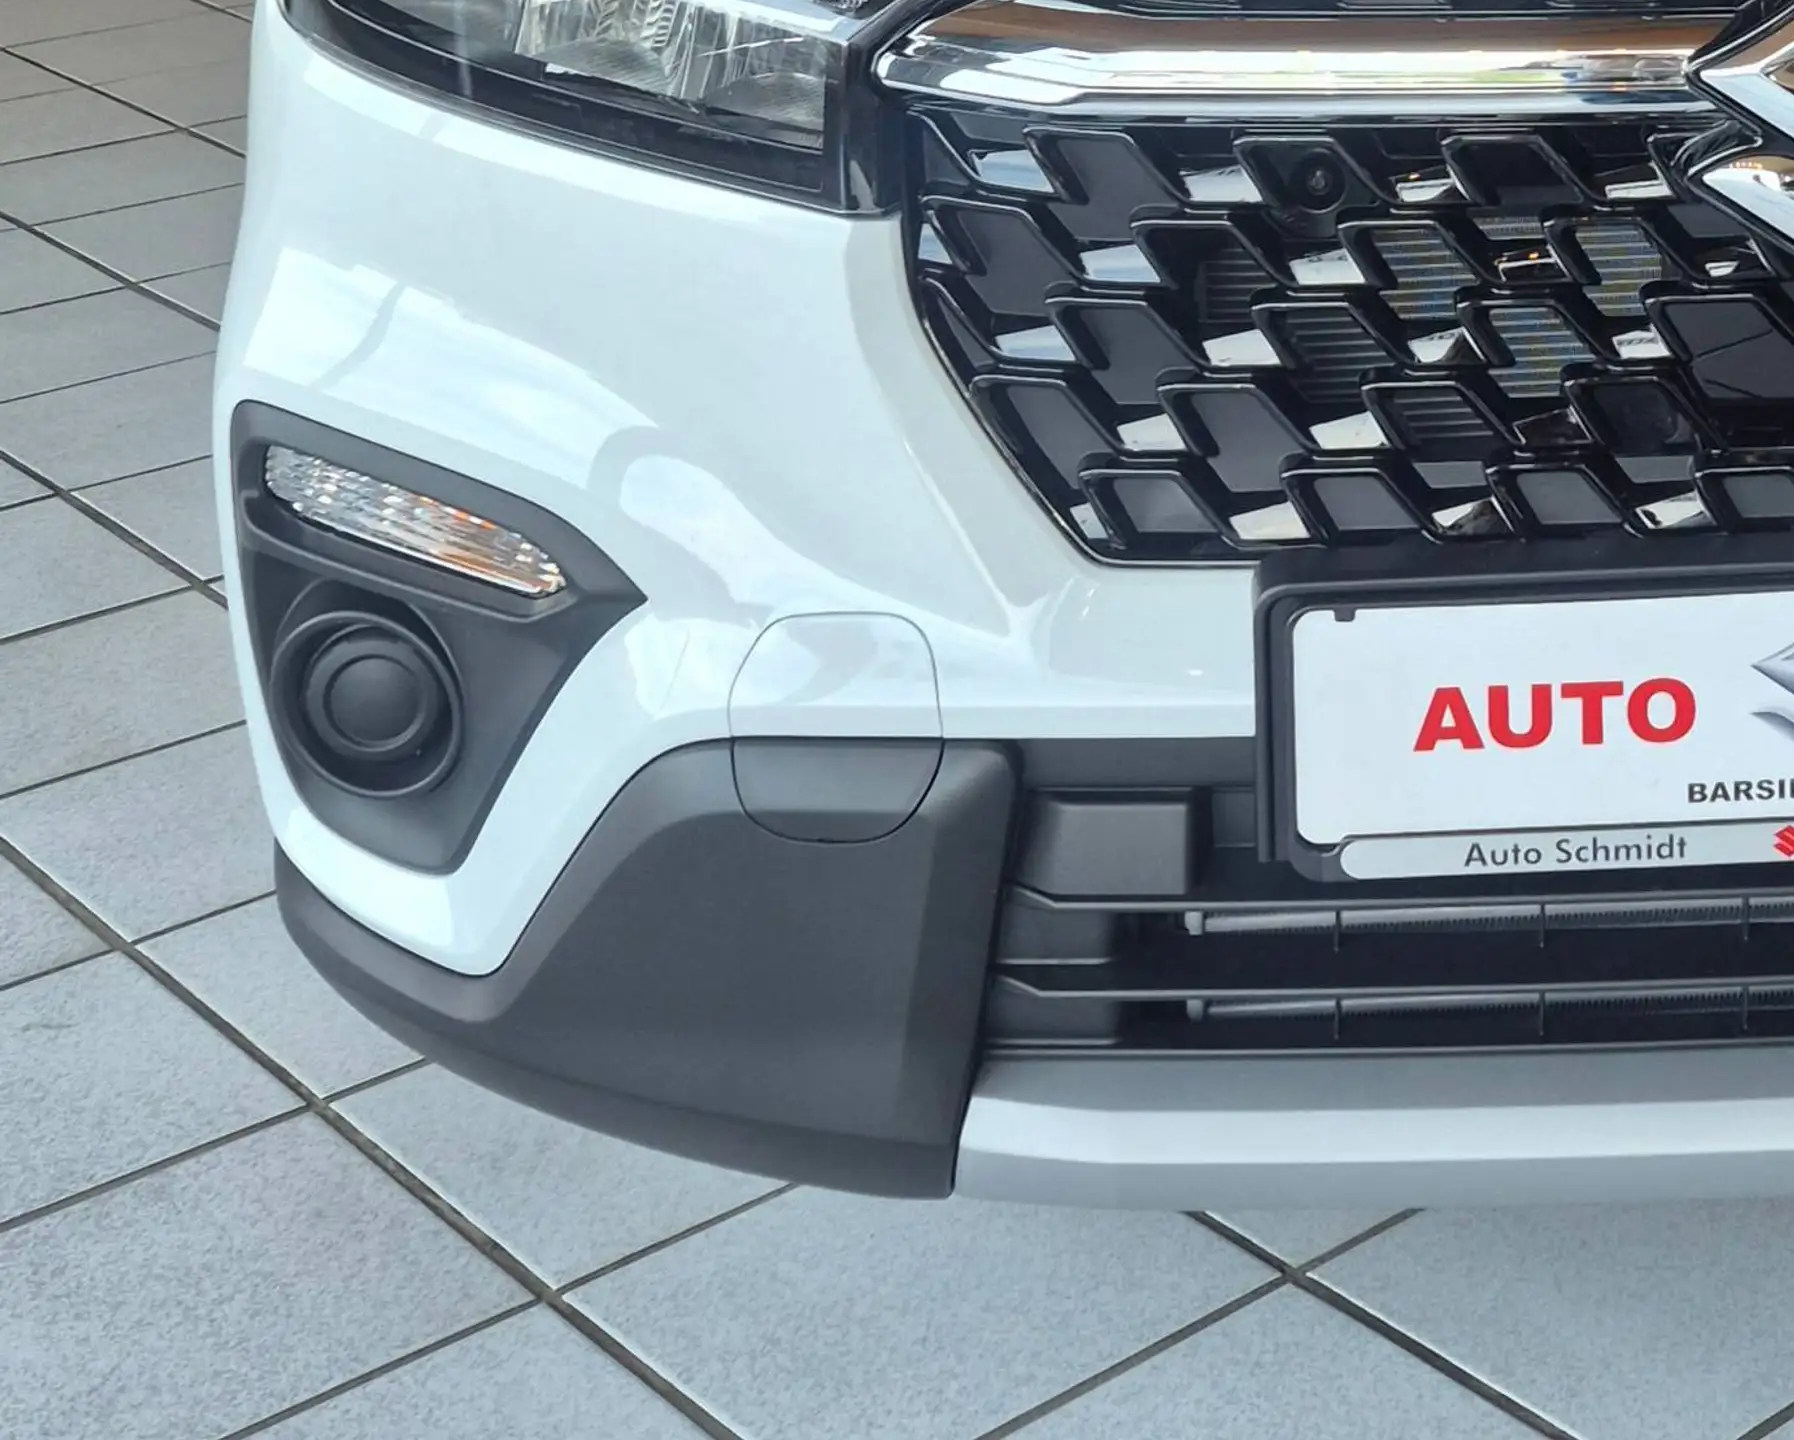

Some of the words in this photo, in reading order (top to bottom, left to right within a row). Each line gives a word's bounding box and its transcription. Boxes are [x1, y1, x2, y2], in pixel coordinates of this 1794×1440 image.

[1414, 678, 1696, 753] AUTO
[1465, 843, 1542, 866] Auto
[1555, 833, 1687, 864] Schmidt
